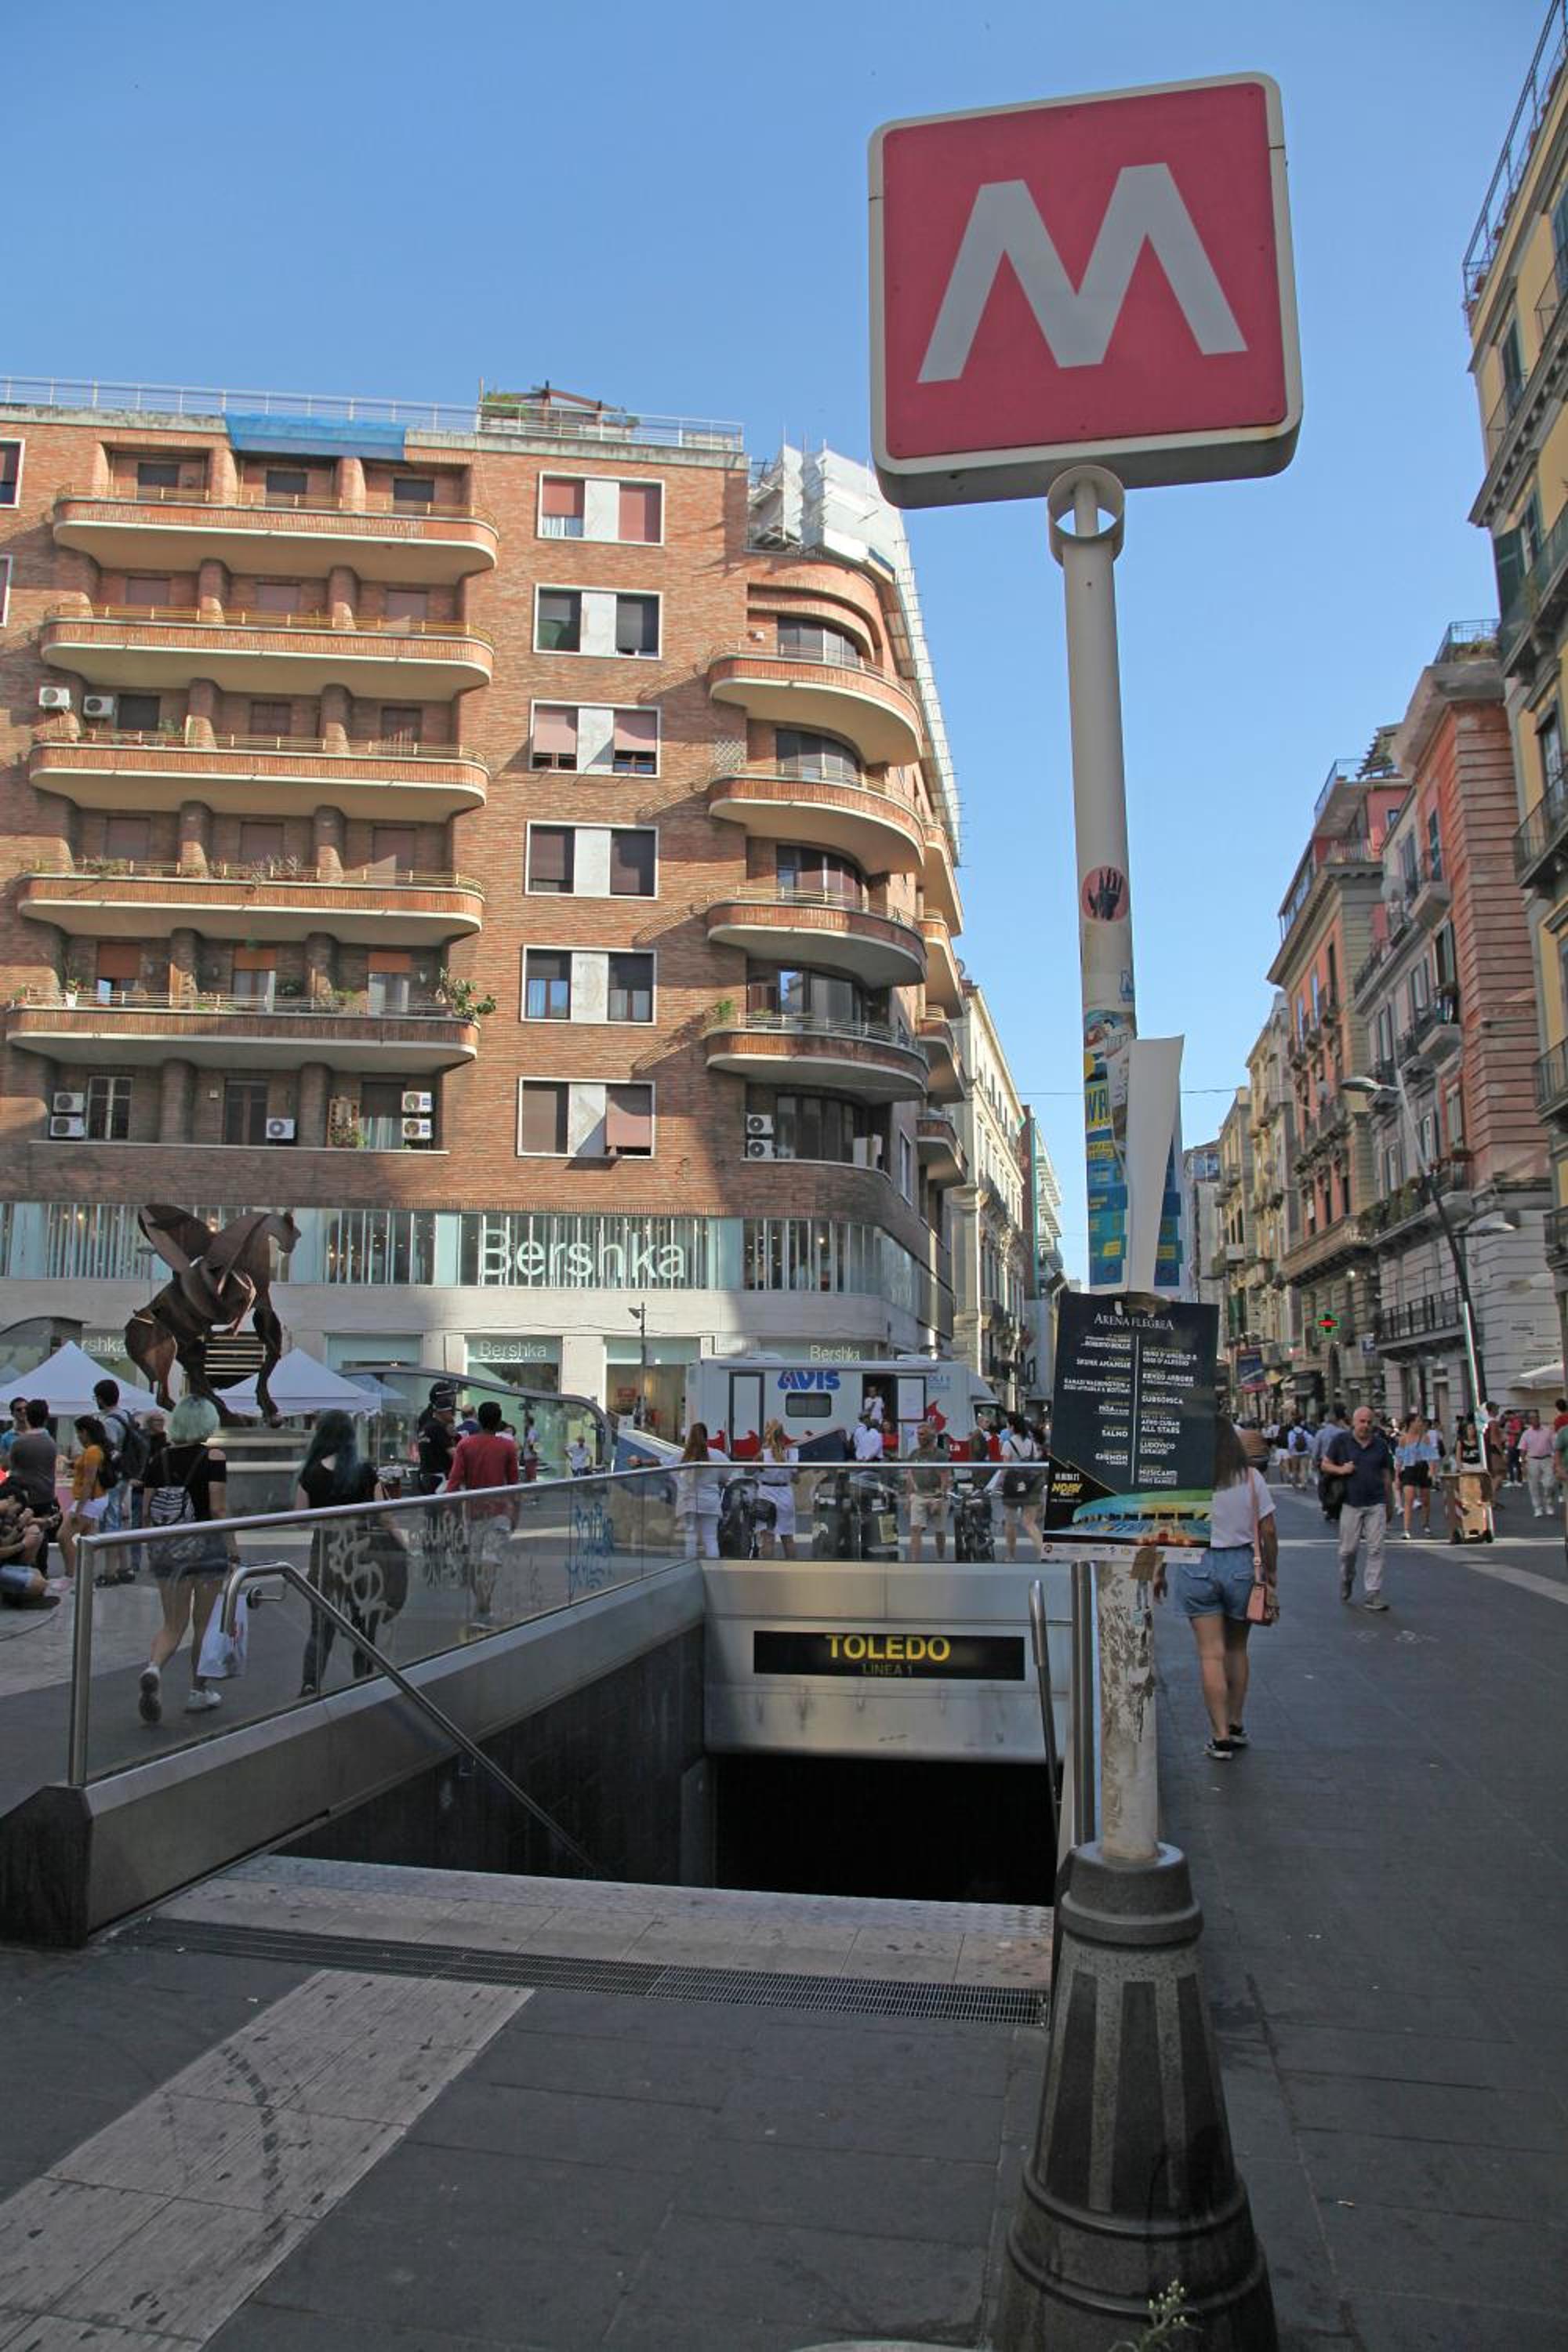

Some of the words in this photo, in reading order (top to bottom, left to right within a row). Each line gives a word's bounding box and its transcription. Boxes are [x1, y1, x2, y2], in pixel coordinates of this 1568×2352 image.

[916, 162, 1248, 383] M
[479, 1229, 684, 1279] Bershka
[1094, 1312, 1130, 1327] ARENA
[81, 1335, 125, 1352] rshka
[479, 1341, 547, 1358] Bershka
[810, 1345, 860, 1362] Bershka
[778, 1370, 840, 1390] AVIS
[826, 1634, 950, 1661] TOLEDO
[863, 1663, 902, 1676] LINEA
[908, 1664, 913, 1676] 1
